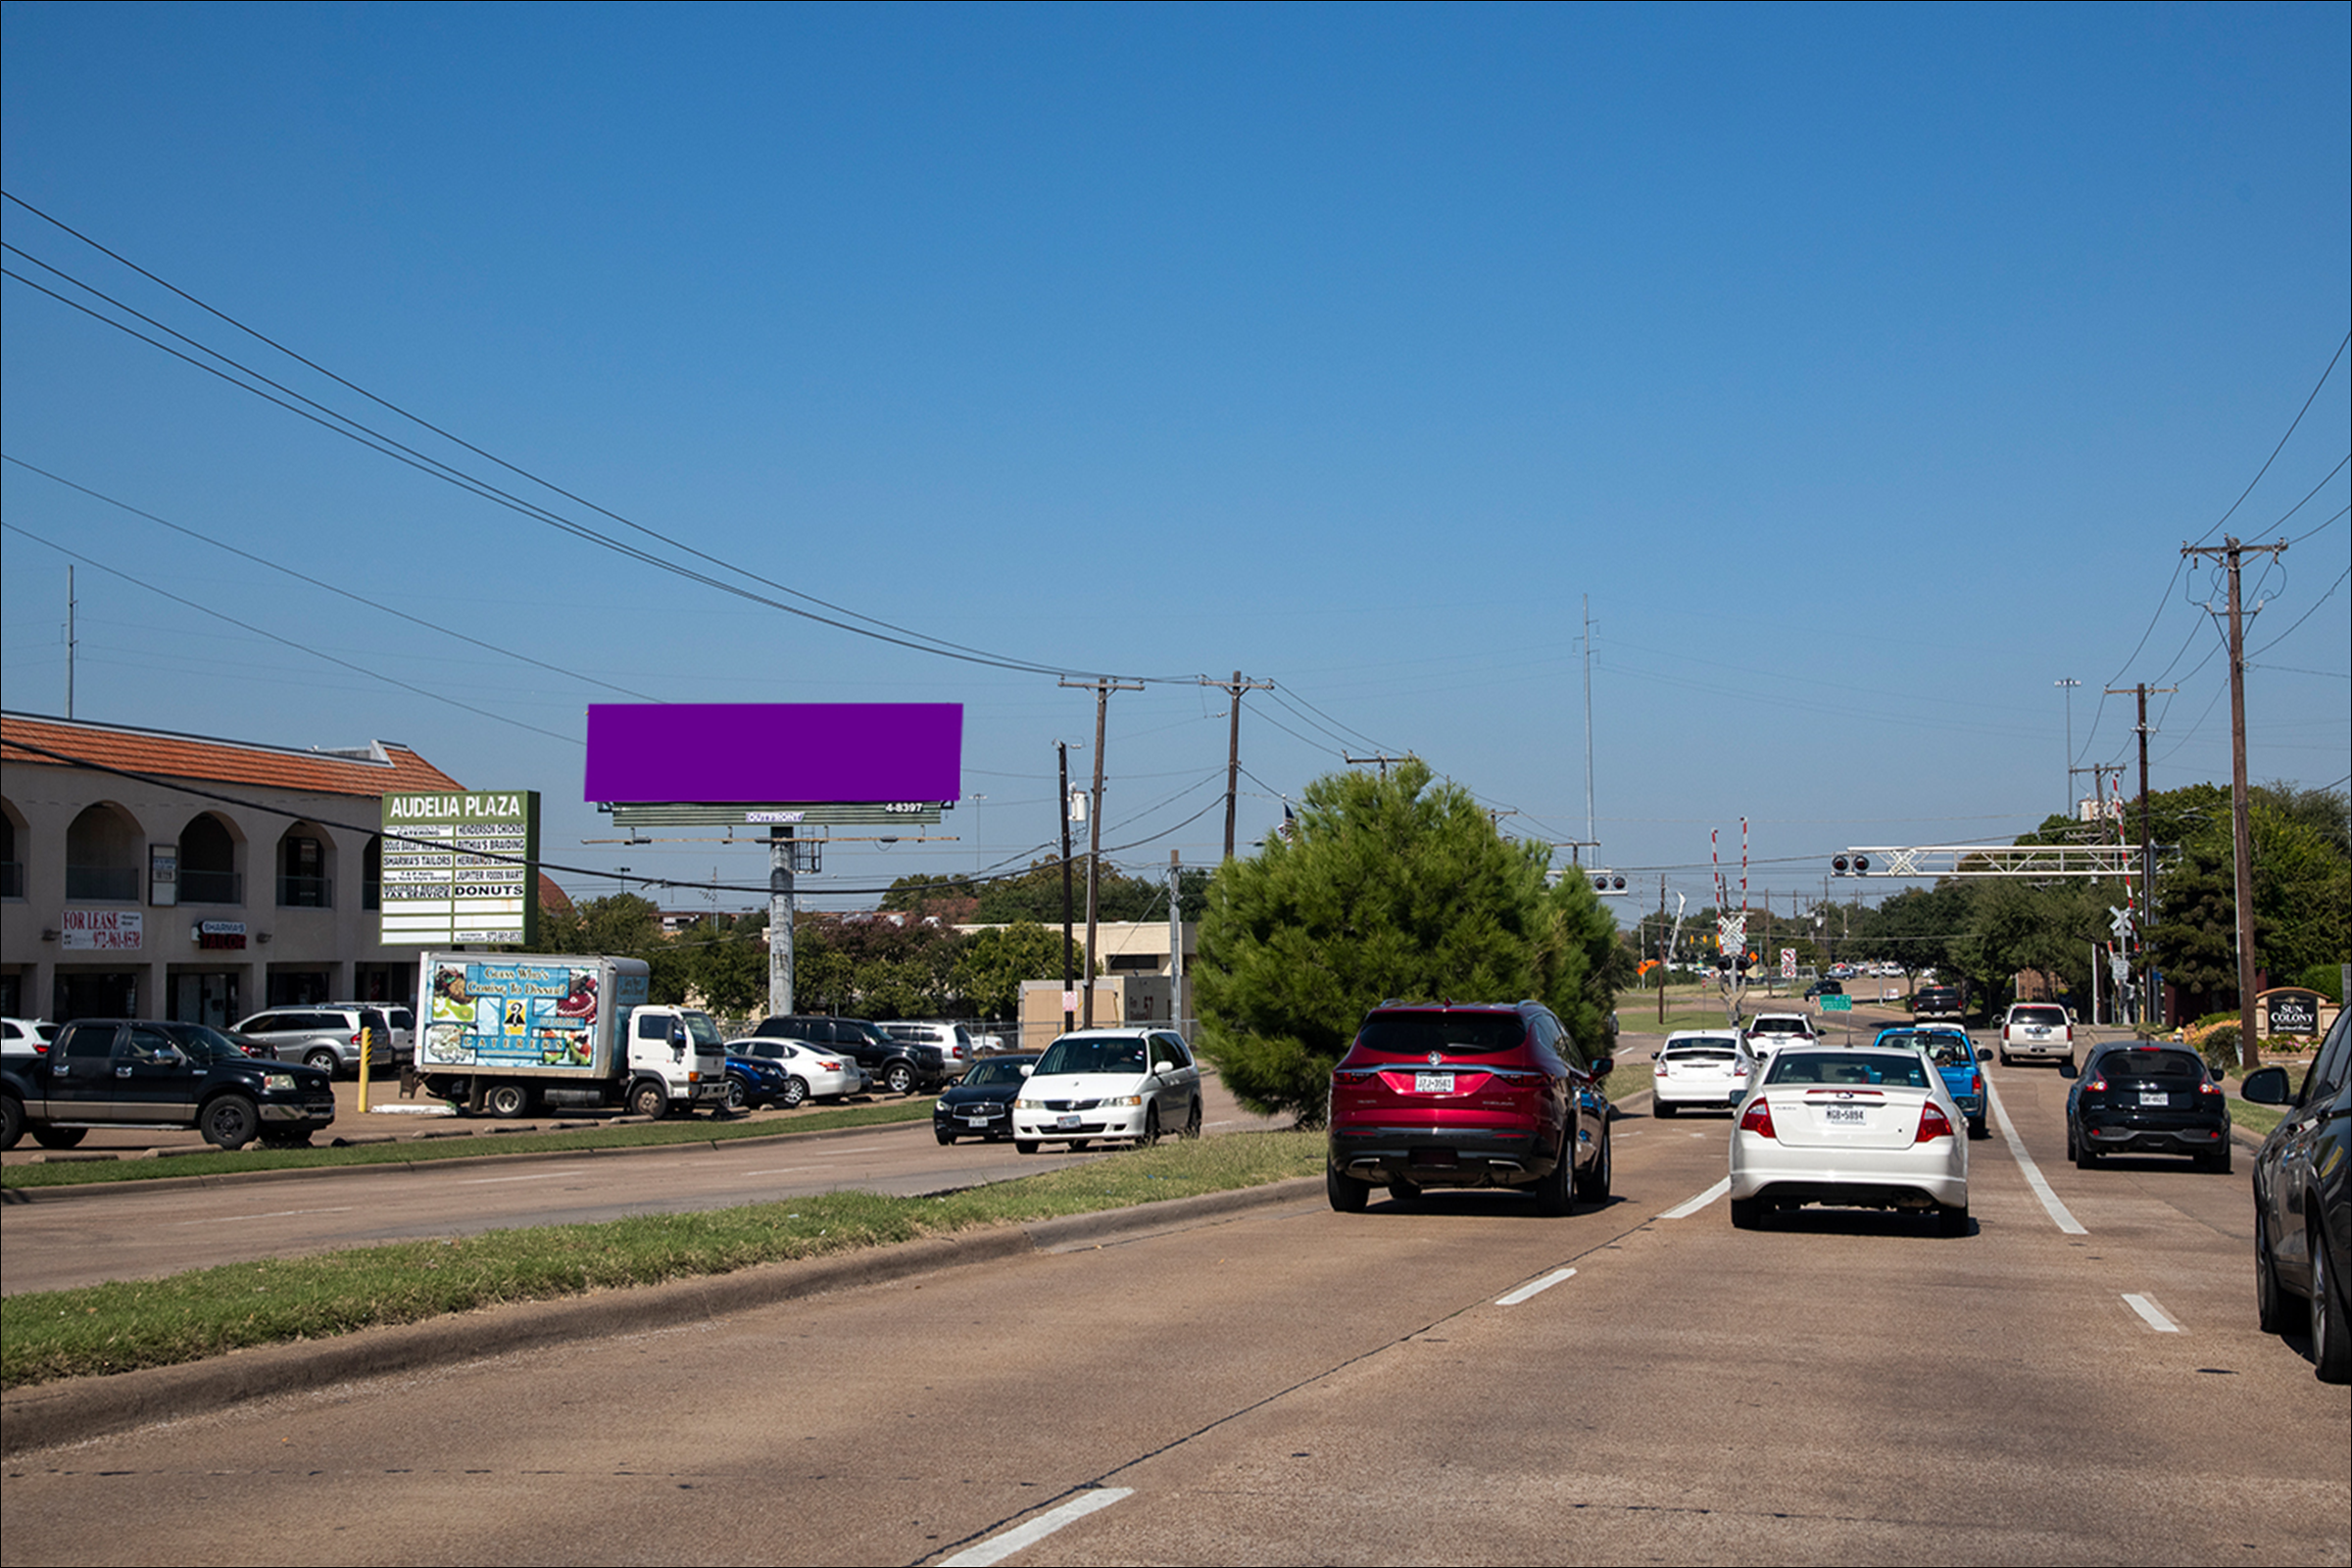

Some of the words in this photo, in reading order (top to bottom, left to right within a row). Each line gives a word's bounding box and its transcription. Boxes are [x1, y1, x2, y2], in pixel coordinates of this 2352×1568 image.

[390, 796, 461, 817] AUDELIA
[465, 796, 520, 817] PLAZA
[885, 803, 923, 812] 4-8397
[748, 812, 804, 822] OUTFRONT
[459, 824, 496, 835] HENDERSON
[498, 824, 525, 834] CHICKEN
[490, 839, 524, 850] BRAIDING
[383, 856, 419, 866] SHARMA'S
[421, 856, 451, 865] TAILORS
[457, 870, 484, 881] JUPITER
[505, 870, 523, 879] MART
[455, 885, 523, 896] DONUTS
[64, 911, 85, 930] FOR
[87, 911, 119, 930] LEASE
[203, 934, 247, 949] TAILOR
[484, 967, 515, 980] GUESS
[517, 967, 549, 980] WHO'S
[467, 983, 507, 996] COMING
[510, 983, 522, 994] TO
[2280, 1004, 2304, 1013] SUN
[2271, 1012, 2314, 1022] COLONY
[464, 1038, 564, 1050] CATERERS
